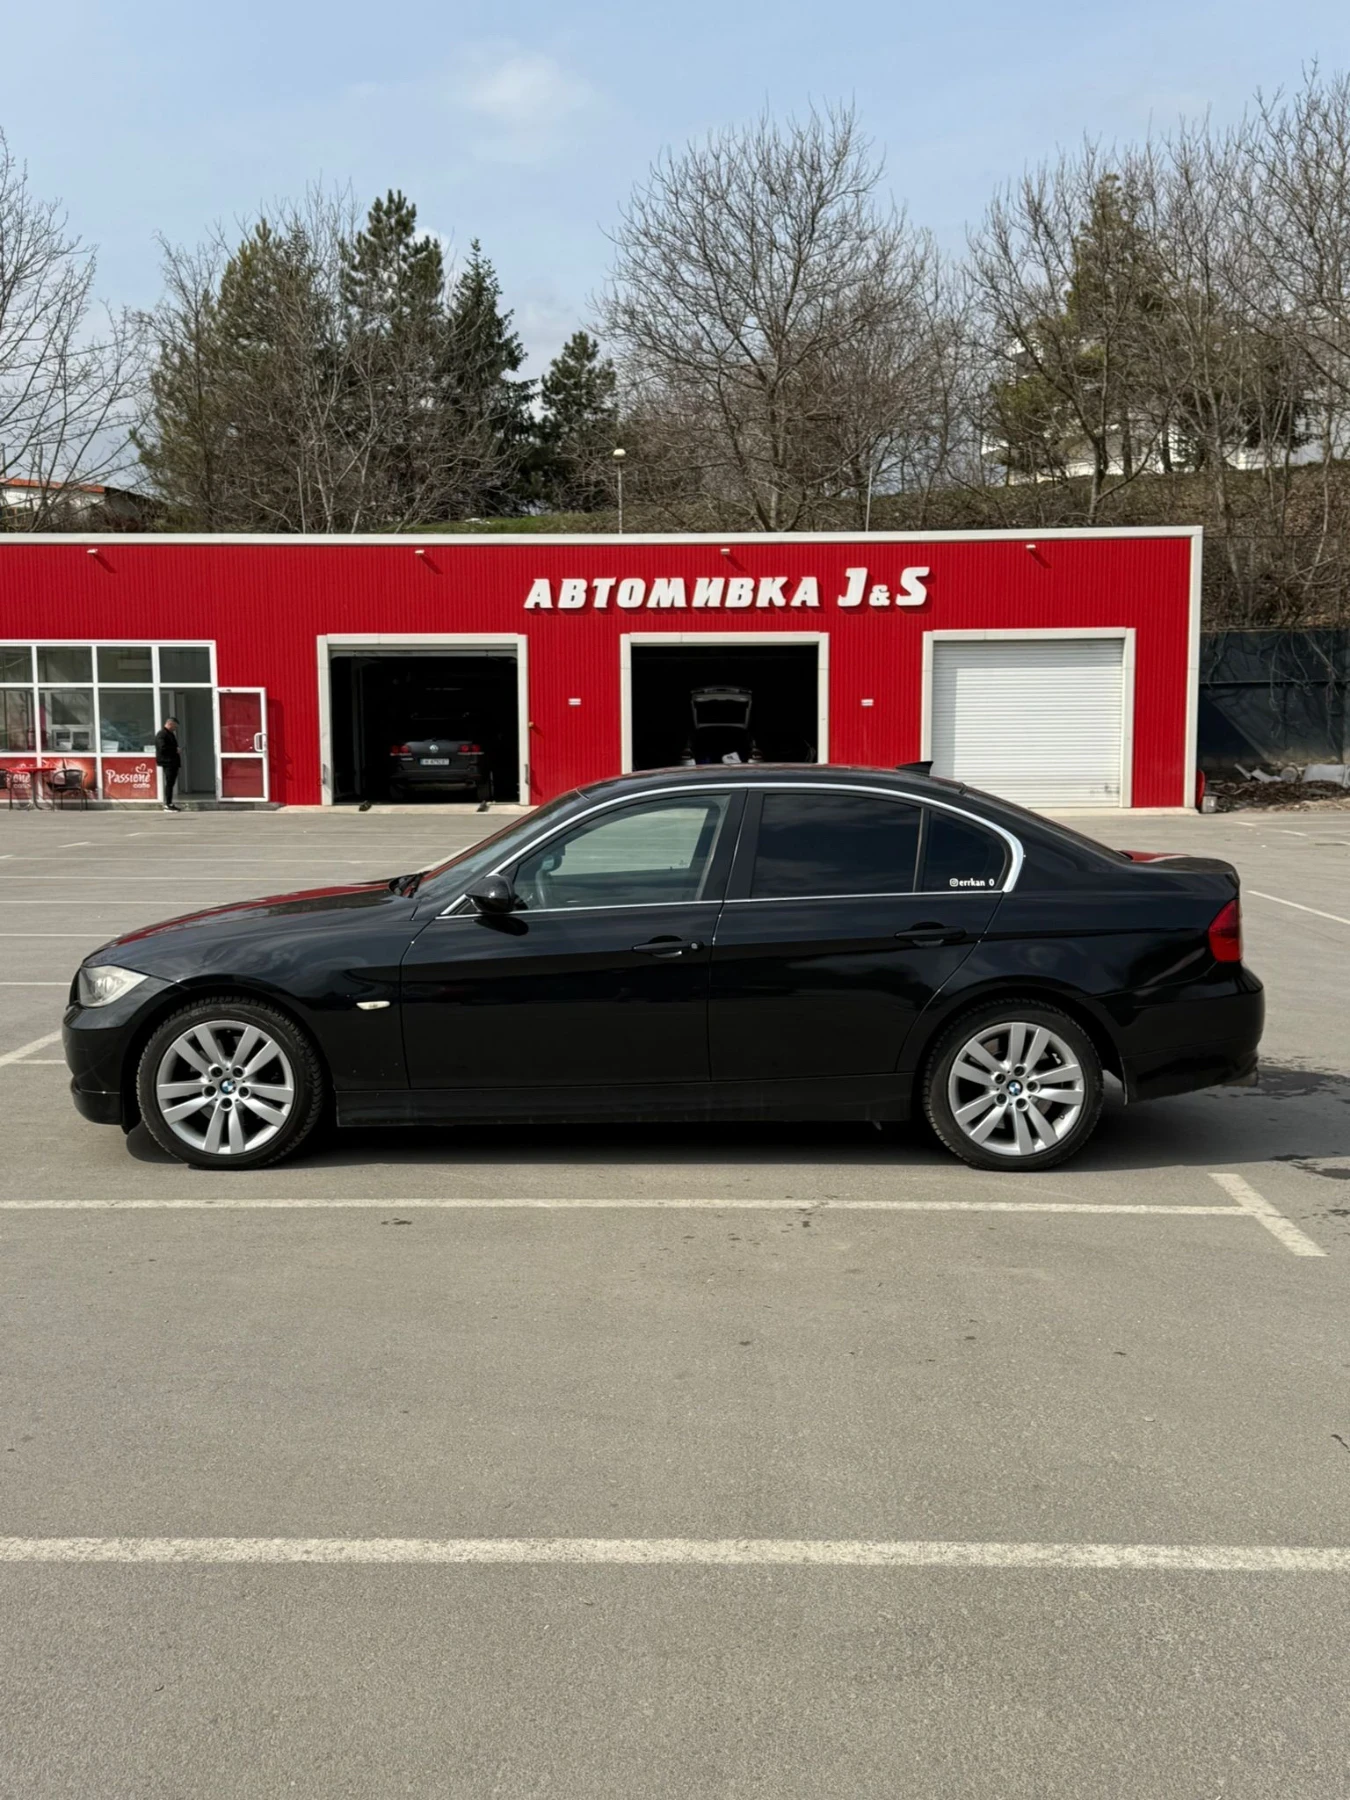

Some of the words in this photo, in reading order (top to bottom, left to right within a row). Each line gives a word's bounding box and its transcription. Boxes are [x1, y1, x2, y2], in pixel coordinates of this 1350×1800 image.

[523, 576, 820, 609] АВТОМИВКА
[837, 565, 931, 608] J&S
[106, 767, 153, 784] Passione
